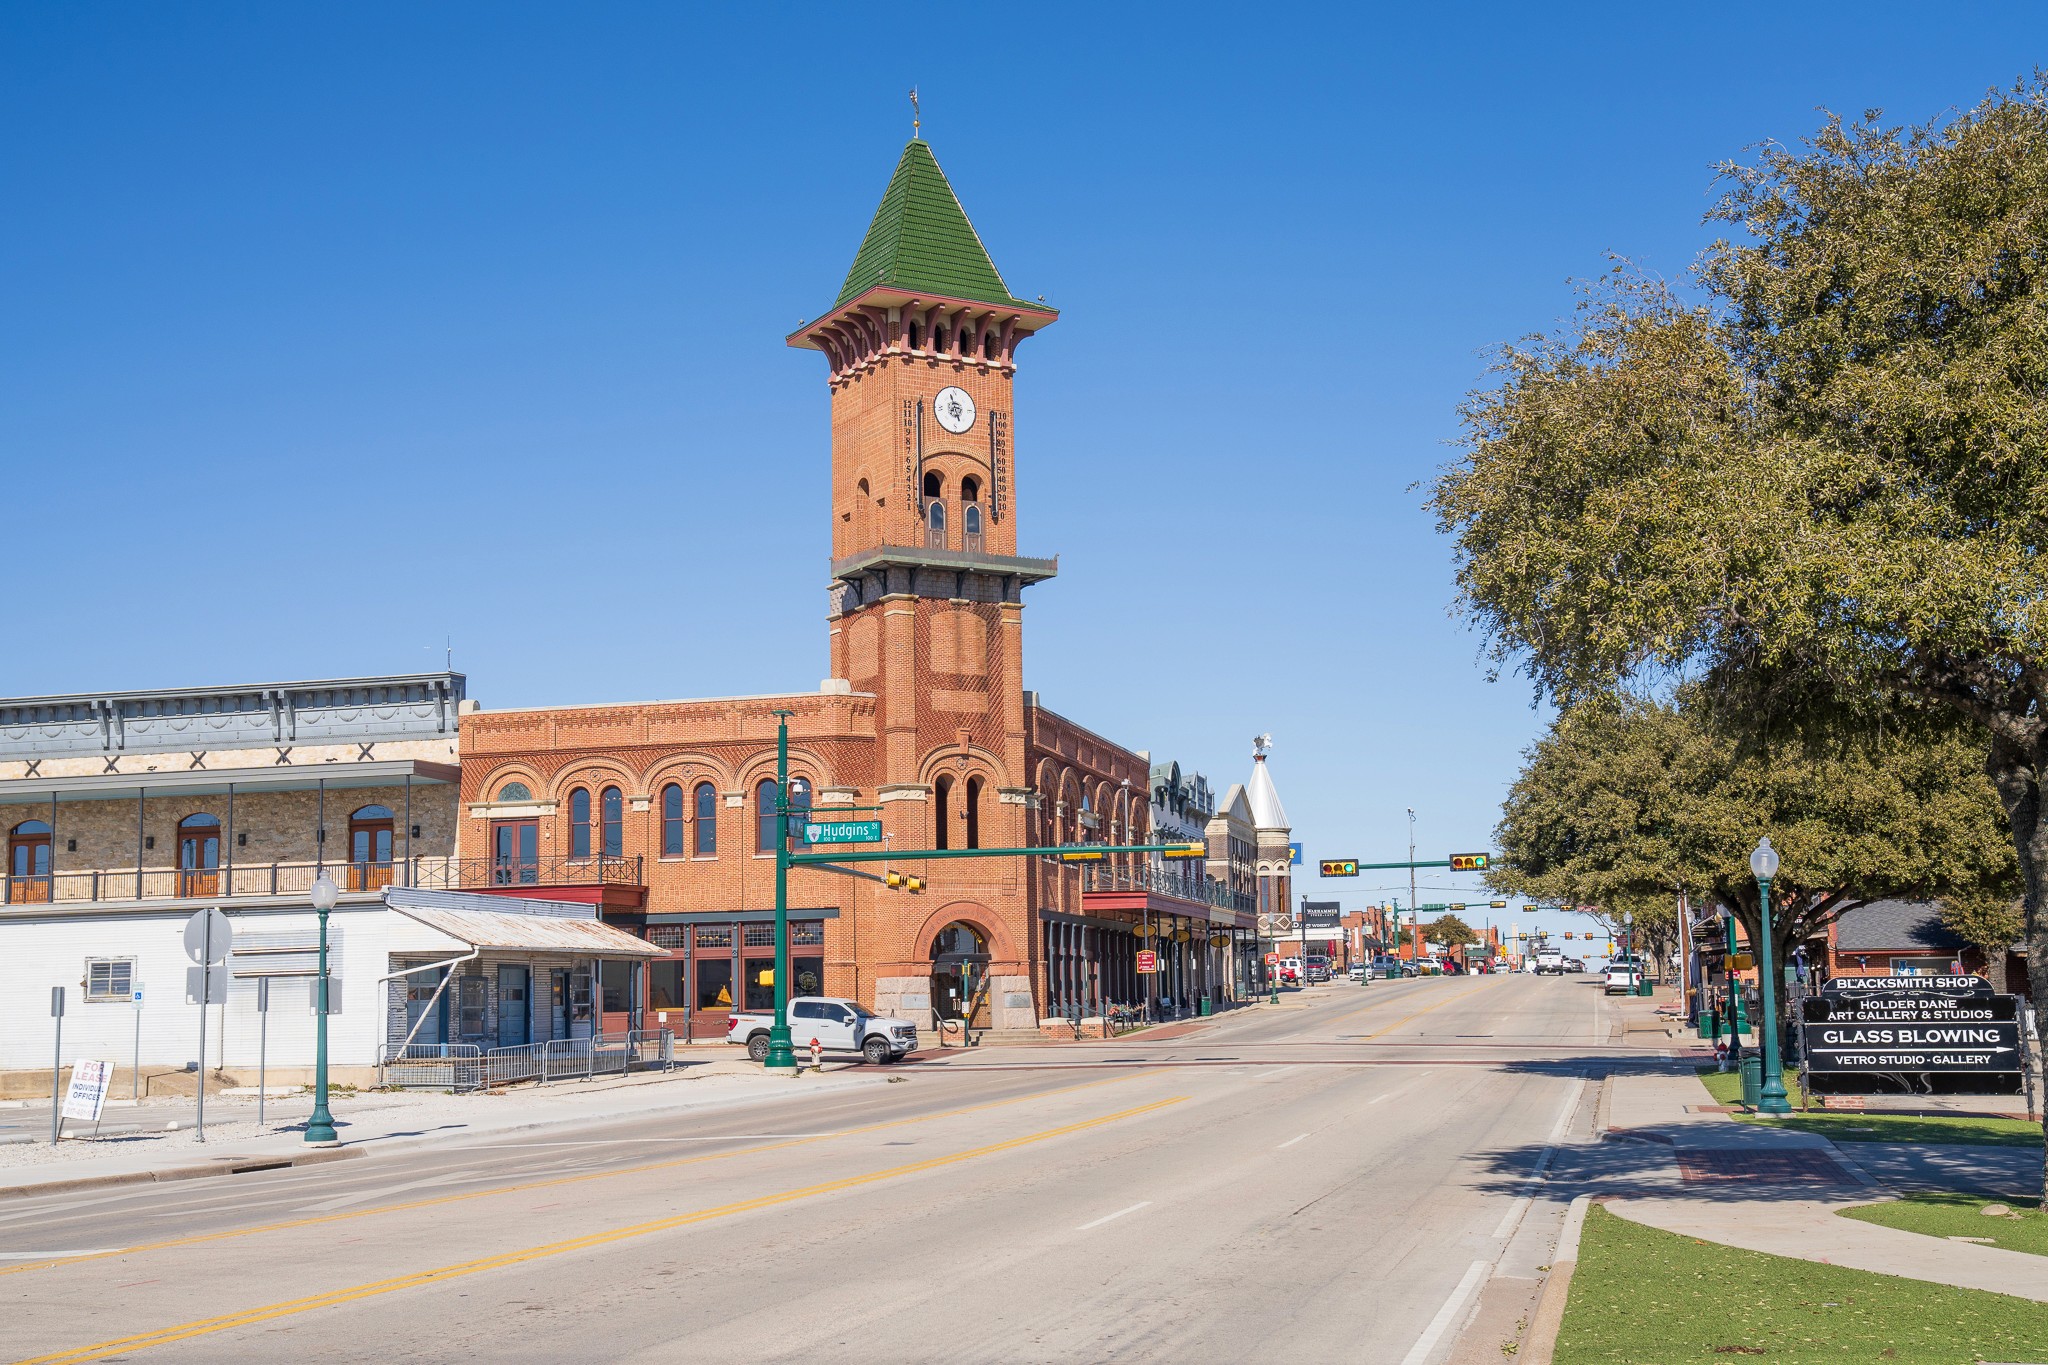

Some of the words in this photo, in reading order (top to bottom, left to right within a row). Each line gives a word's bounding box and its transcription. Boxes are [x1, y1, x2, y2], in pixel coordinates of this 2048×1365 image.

[903, 400, 912, 408] 12
[903, 409, 911, 417] 11
[995, 411, 1007, 420] 110
[903, 419, 912, 427] 10
[995, 421, 1007, 429] 100
[905, 428, 911, 436] 9
[997, 440, 1005, 448] 80
[906, 446, 911, 454] 7
[997, 448, 1005, 456] 70
[906, 456, 911, 464] 6
[997, 457, 1005, 465] 60
[998, 484, 1006, 492] 30
[823, 824, 869, 840] Hudgins
[1836, 978, 1934, 989] BLACKSMITH
[1936, 977, 1979, 988] SHOP
[1860, 1000, 1916, 1010] HOLDER
[1919, 1000, 1957, 1009] DANE
[1827, 1011, 1854, 1021] ART
[1856, 1011, 1919, 1020] GALLERY
[1921, 1010, 1931, 1019] &
[1934, 1009, 1993, 1019] STUDIOS
[1823, 1030, 1893, 1044] GLASS
[1898, 1029, 2001, 1043] BLOWING
[1835, 1055, 1877, 1065] VETRO
[1879, 1055, 1925, 1064] STUDIO
[1932, 1055, 1992, 1064] GALLERY
[83, 1062, 104, 1072] FOR
[75, 1071, 108, 1083] LEASE
[72, 1091, 101, 1101] OFFICES
